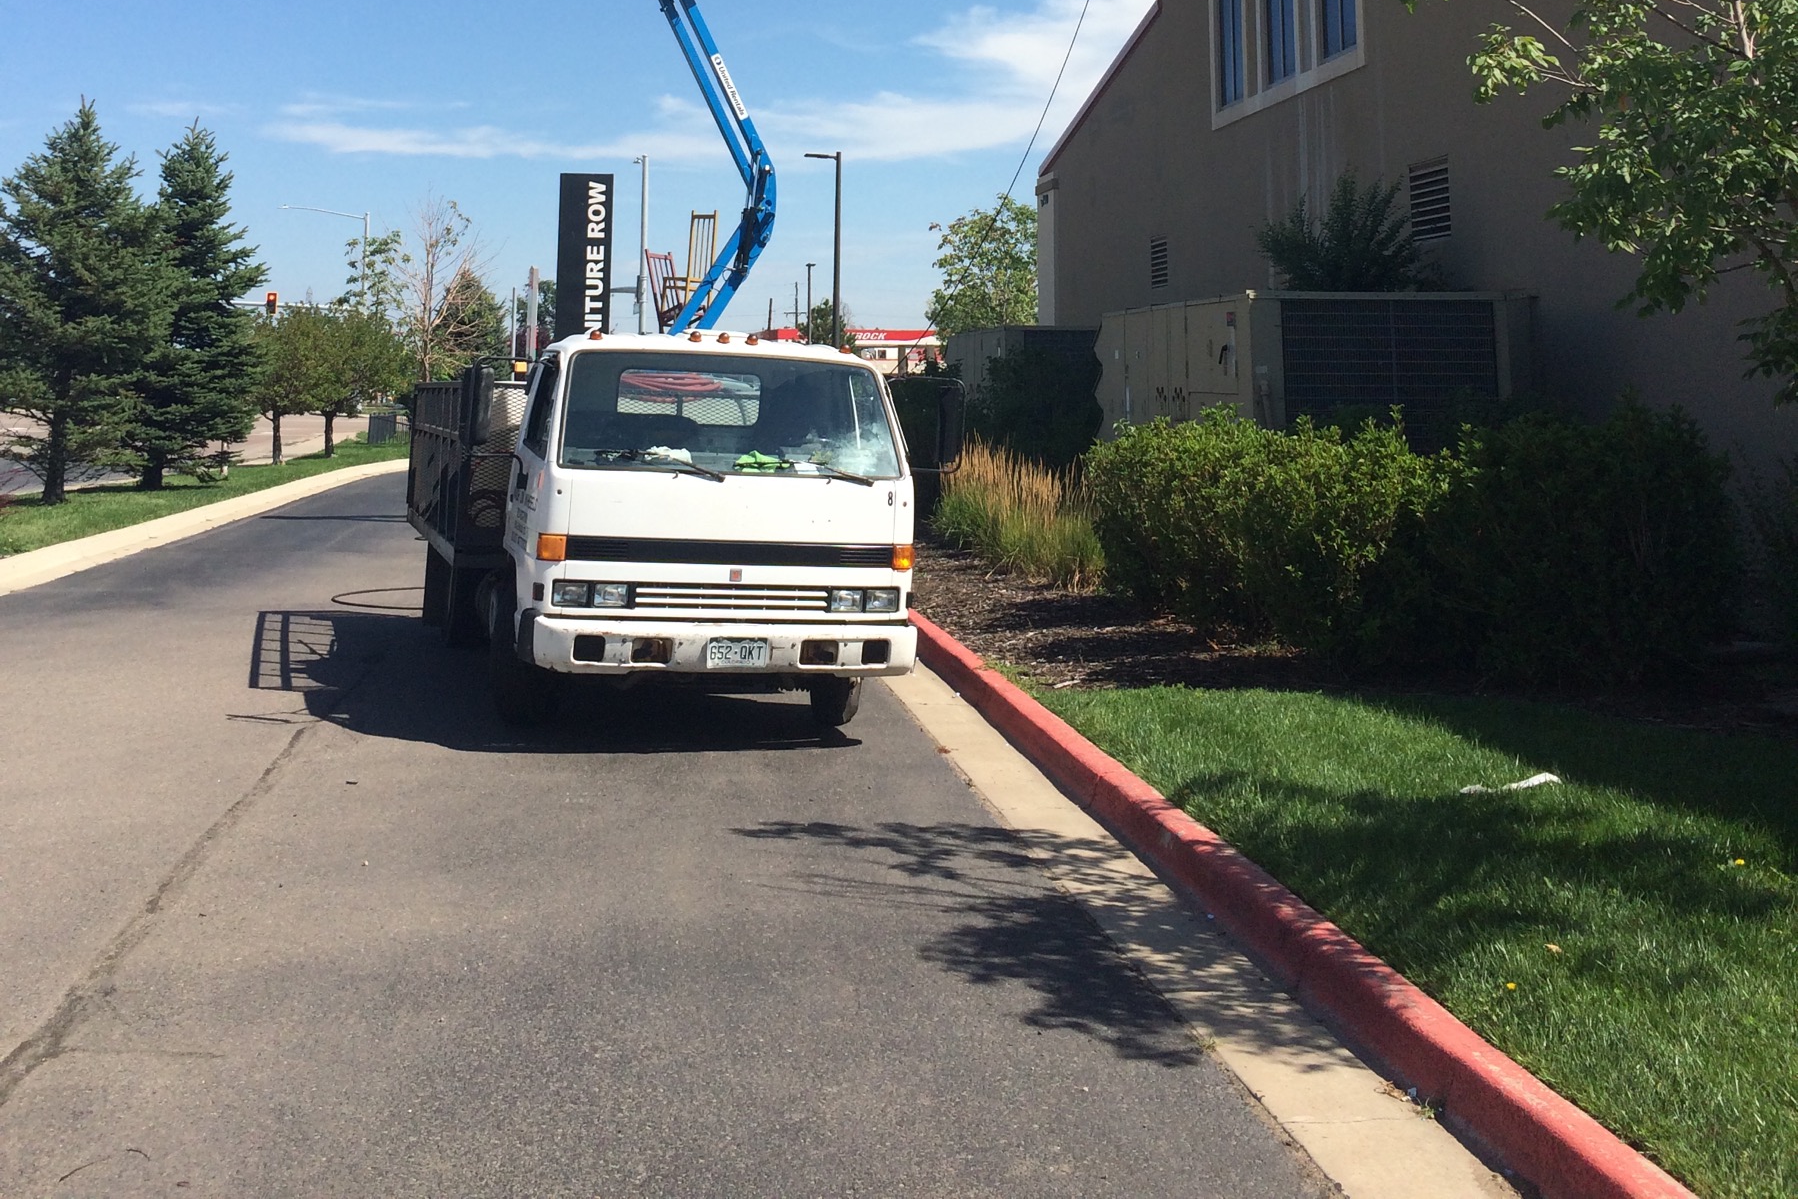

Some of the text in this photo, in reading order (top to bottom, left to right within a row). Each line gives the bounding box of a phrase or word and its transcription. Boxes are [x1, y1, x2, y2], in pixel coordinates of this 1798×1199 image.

[719, 66, 744, 116] United Rentals
[587, 181, 607, 239] ROW
[888, 491, 893, 506] 8
